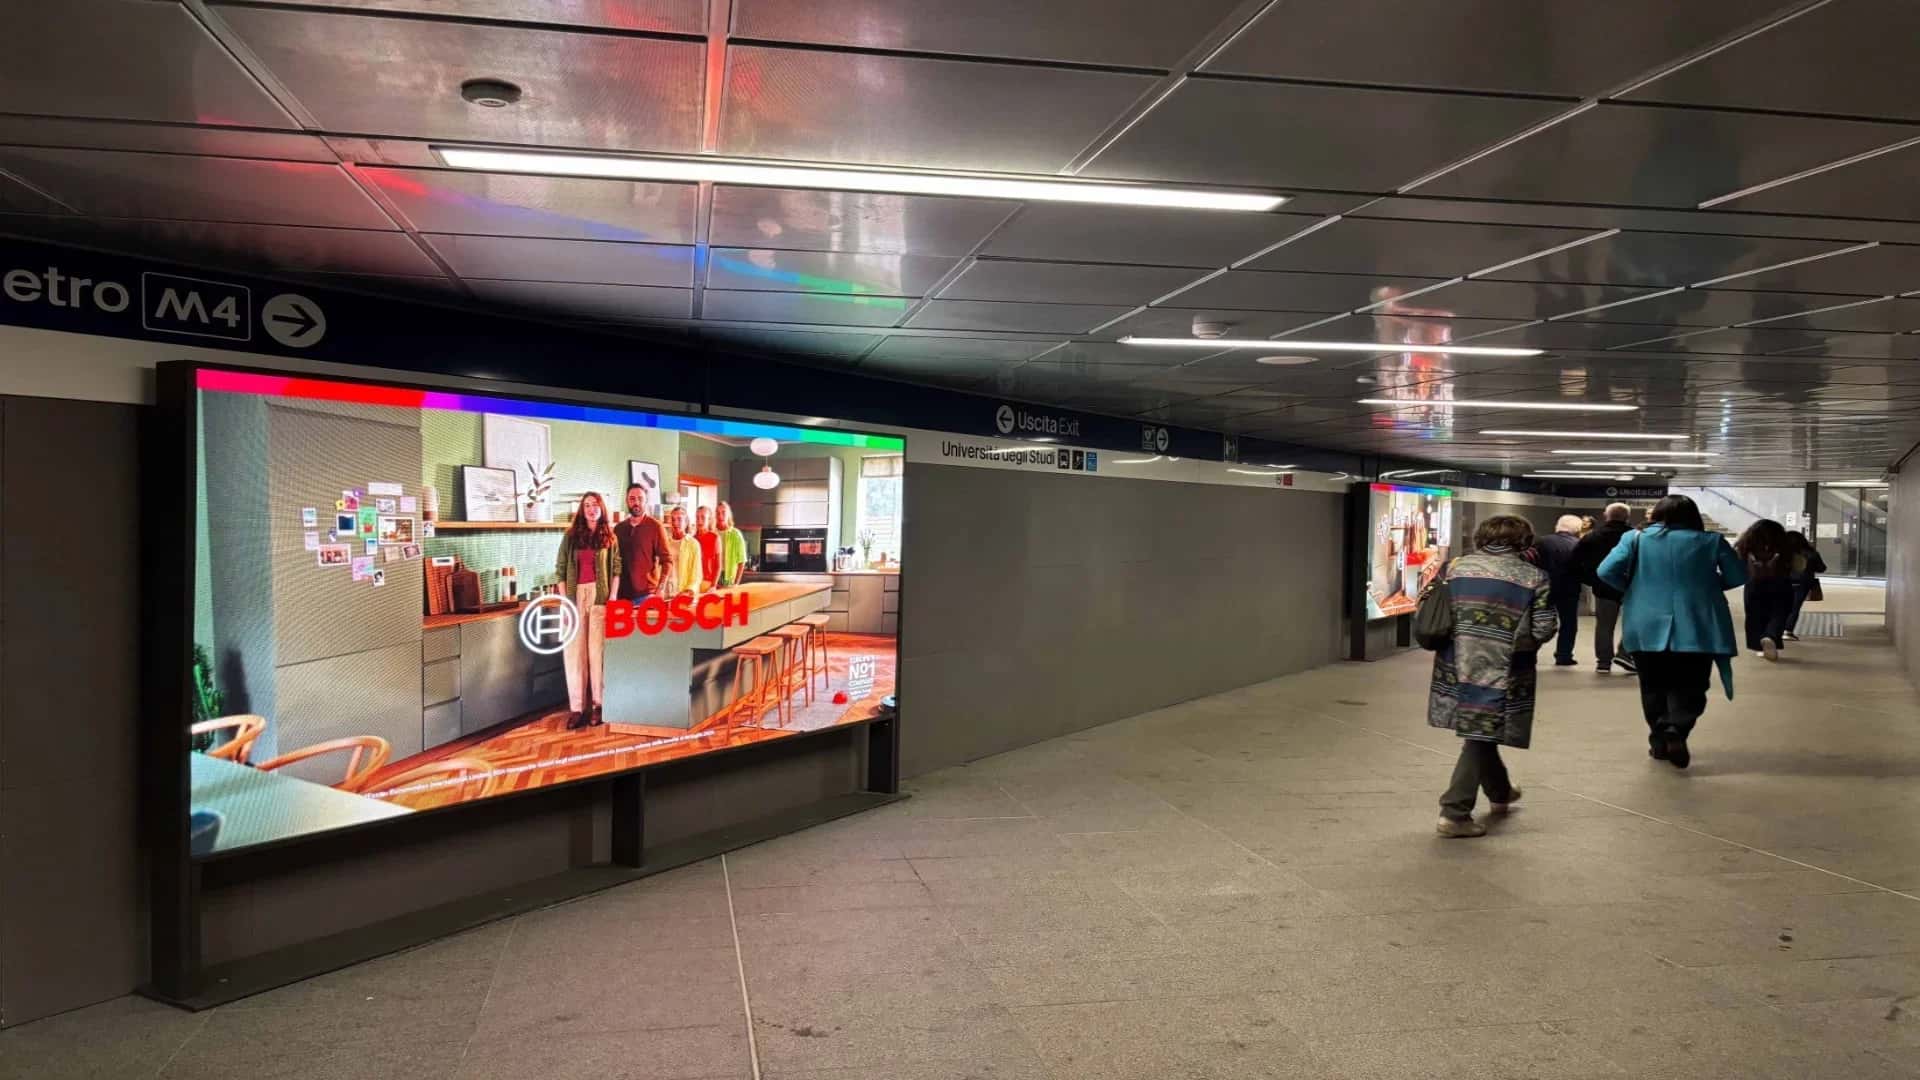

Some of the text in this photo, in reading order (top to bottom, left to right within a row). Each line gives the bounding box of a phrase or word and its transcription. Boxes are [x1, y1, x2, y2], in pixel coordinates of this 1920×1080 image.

[154, 287, 241, 328] M4
[1017, 411, 1080, 437] Uscita Exit
[1029, 450, 1055, 465] Studi
[604, 591, 750, 639] BOSCH
